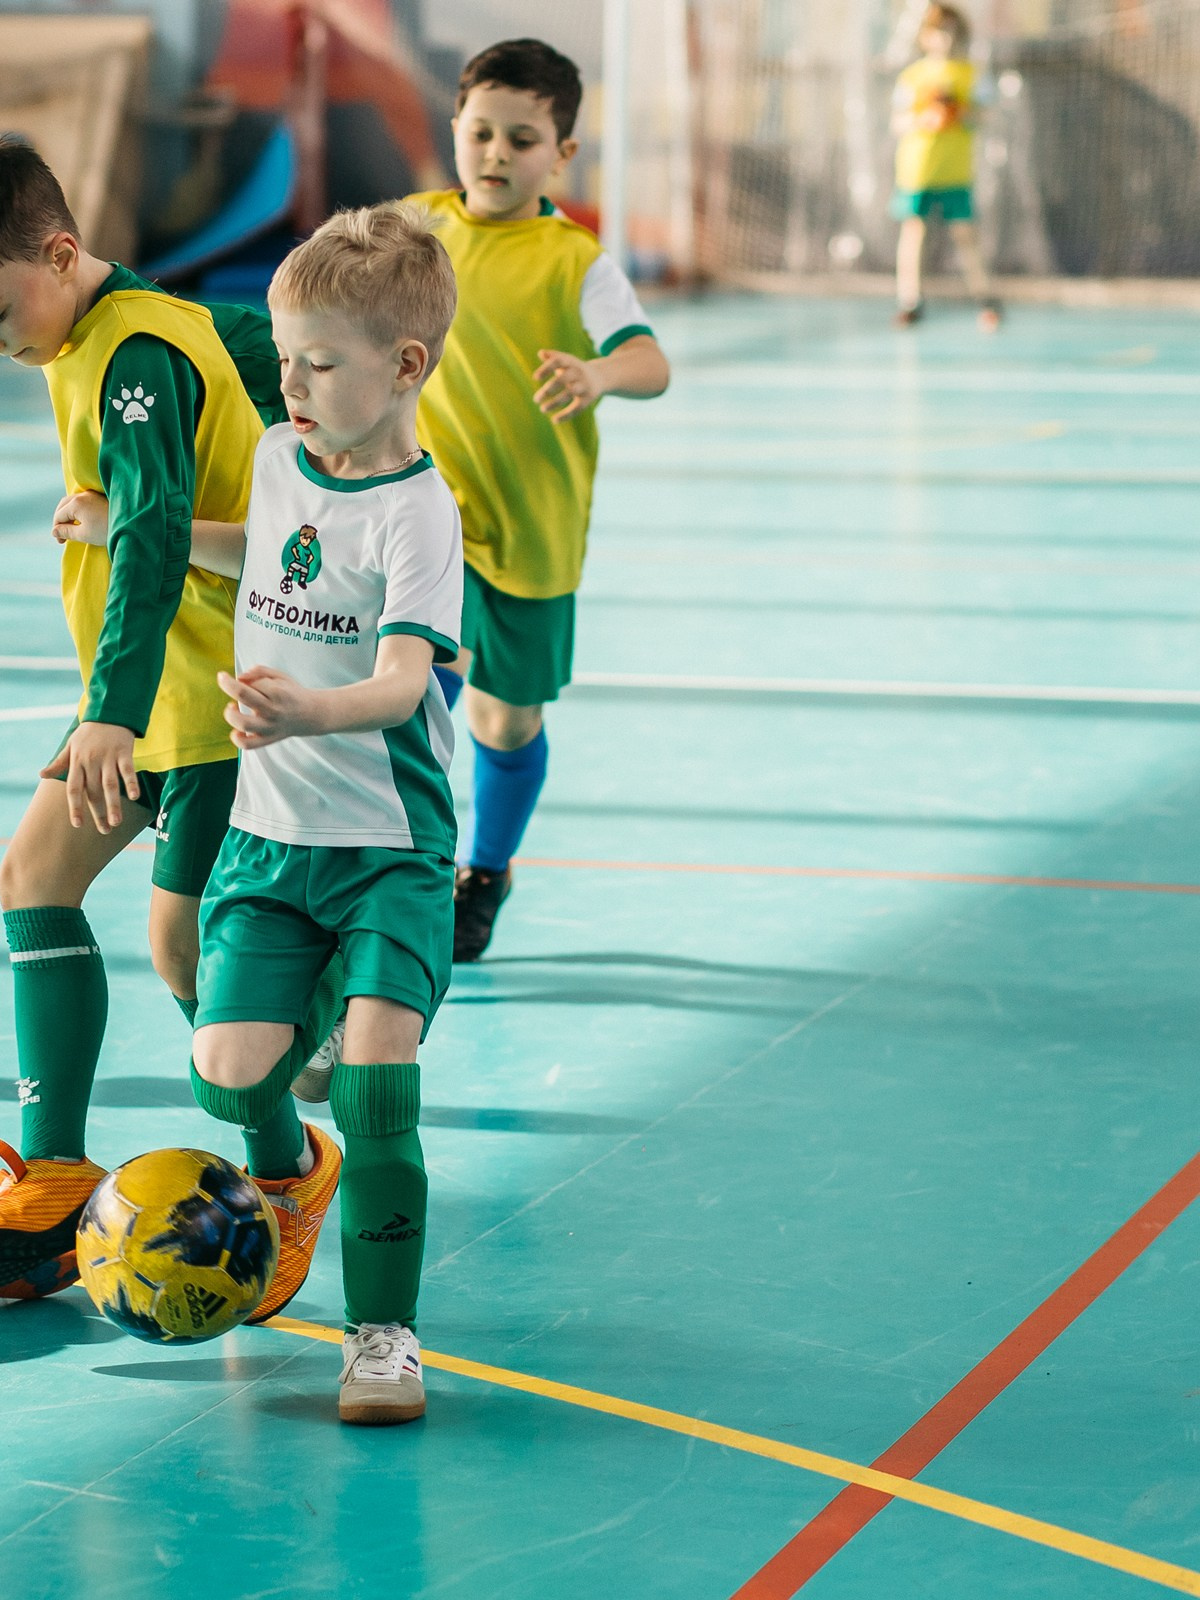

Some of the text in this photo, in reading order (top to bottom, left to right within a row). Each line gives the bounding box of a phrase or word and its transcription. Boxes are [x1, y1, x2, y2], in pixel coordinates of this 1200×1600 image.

[249, 589, 360, 634] ФУТБОЛИКА
[264, 619, 301, 638] ФУТБОЛА
[303, 632, 323, 642] ДЛЯ
[325, 635, 359, 645] ДЕТЕЙ
[183, 1282, 205, 1330] adidas
